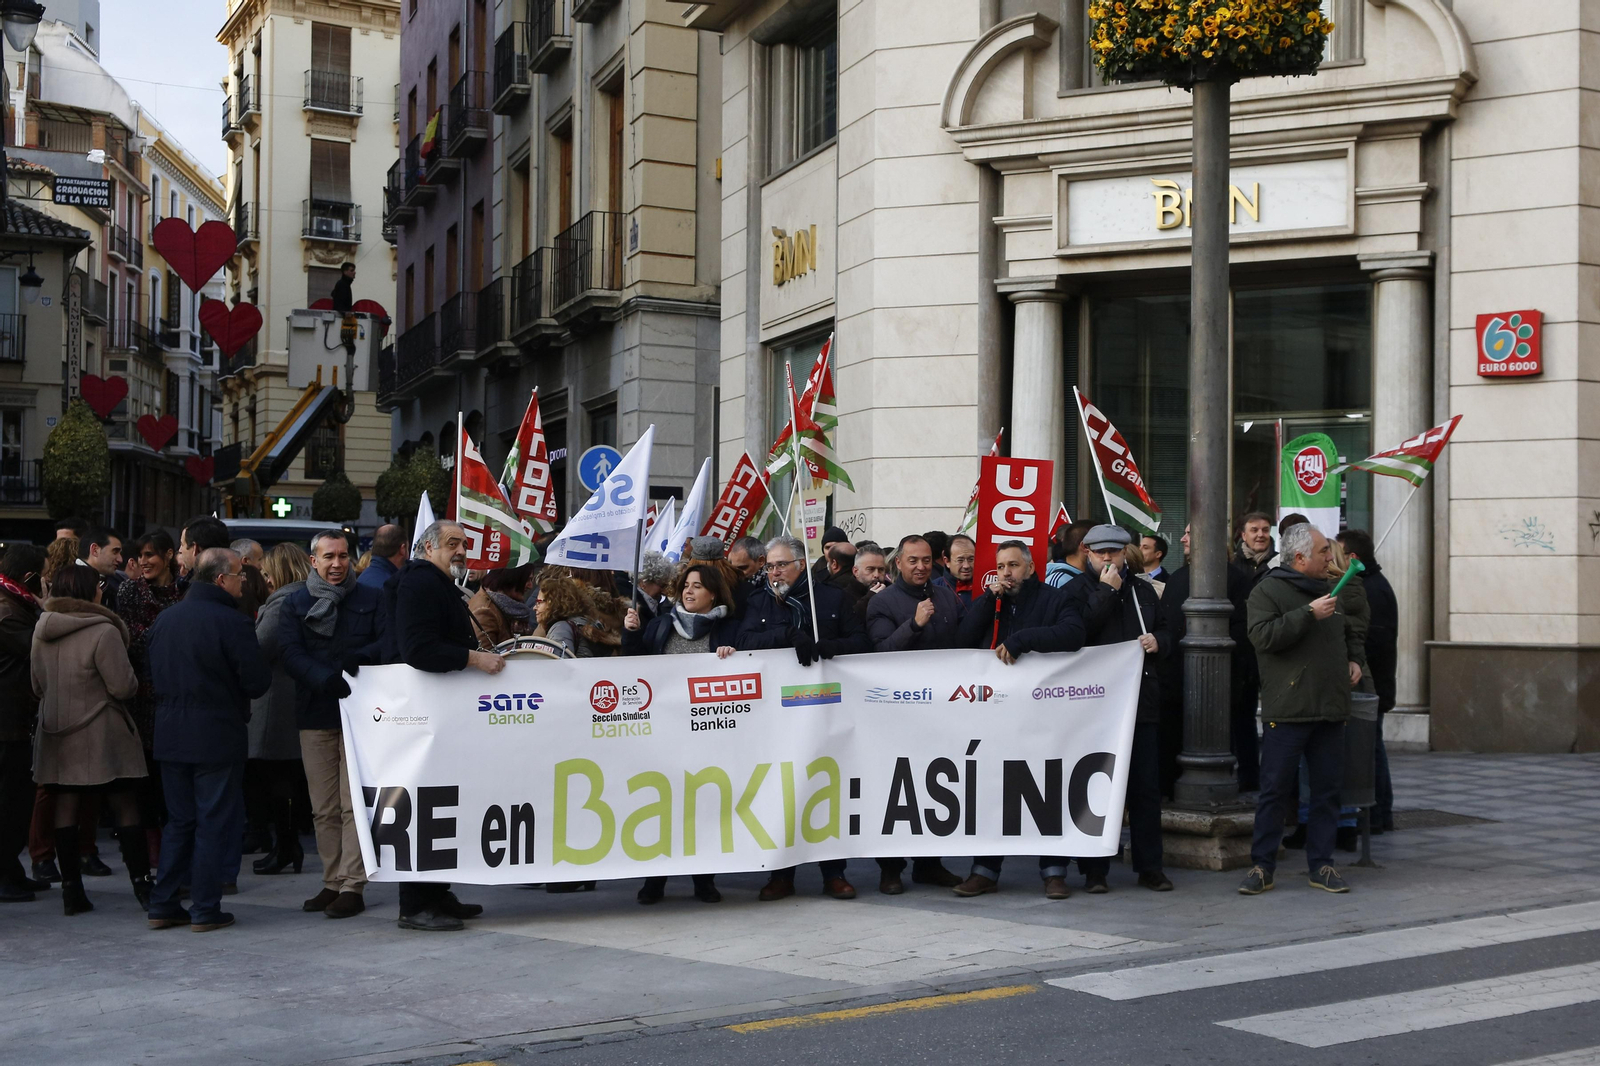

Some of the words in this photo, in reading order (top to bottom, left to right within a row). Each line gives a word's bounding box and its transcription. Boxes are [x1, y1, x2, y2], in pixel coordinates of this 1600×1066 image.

[56, 178, 101, 187] DEPARTAMENTOS
[56, 186, 109, 197] GRADUACION
[55, 195, 67, 203] DE
[69, 196, 81, 204] LA
[83, 197, 109, 206] VISTA
[772, 225, 817, 287] BMN
[1480, 362, 1507, 373] EURO
[1508, 361, 1538, 371] 6000
[296, 505, 313, 517] FA
[621, 685, 638, 696] FeS
[693, 679, 757, 698] CCOO
[893, 687, 933, 701] sesfi
[948, 683, 994, 703] ASIP
[1044, 684, 1106, 699] ACB-Bankia
[690, 702, 751, 717] servicios
[488, 713, 535, 725] Bankia
[592, 713, 622, 723] Sección
[622, 711, 651, 721] Sindical
[690, 717, 736, 731] bankia
[592, 721, 652, 739] Bankia
[481, 802, 535, 868] en
[881, 739, 982, 837] ASÍ
